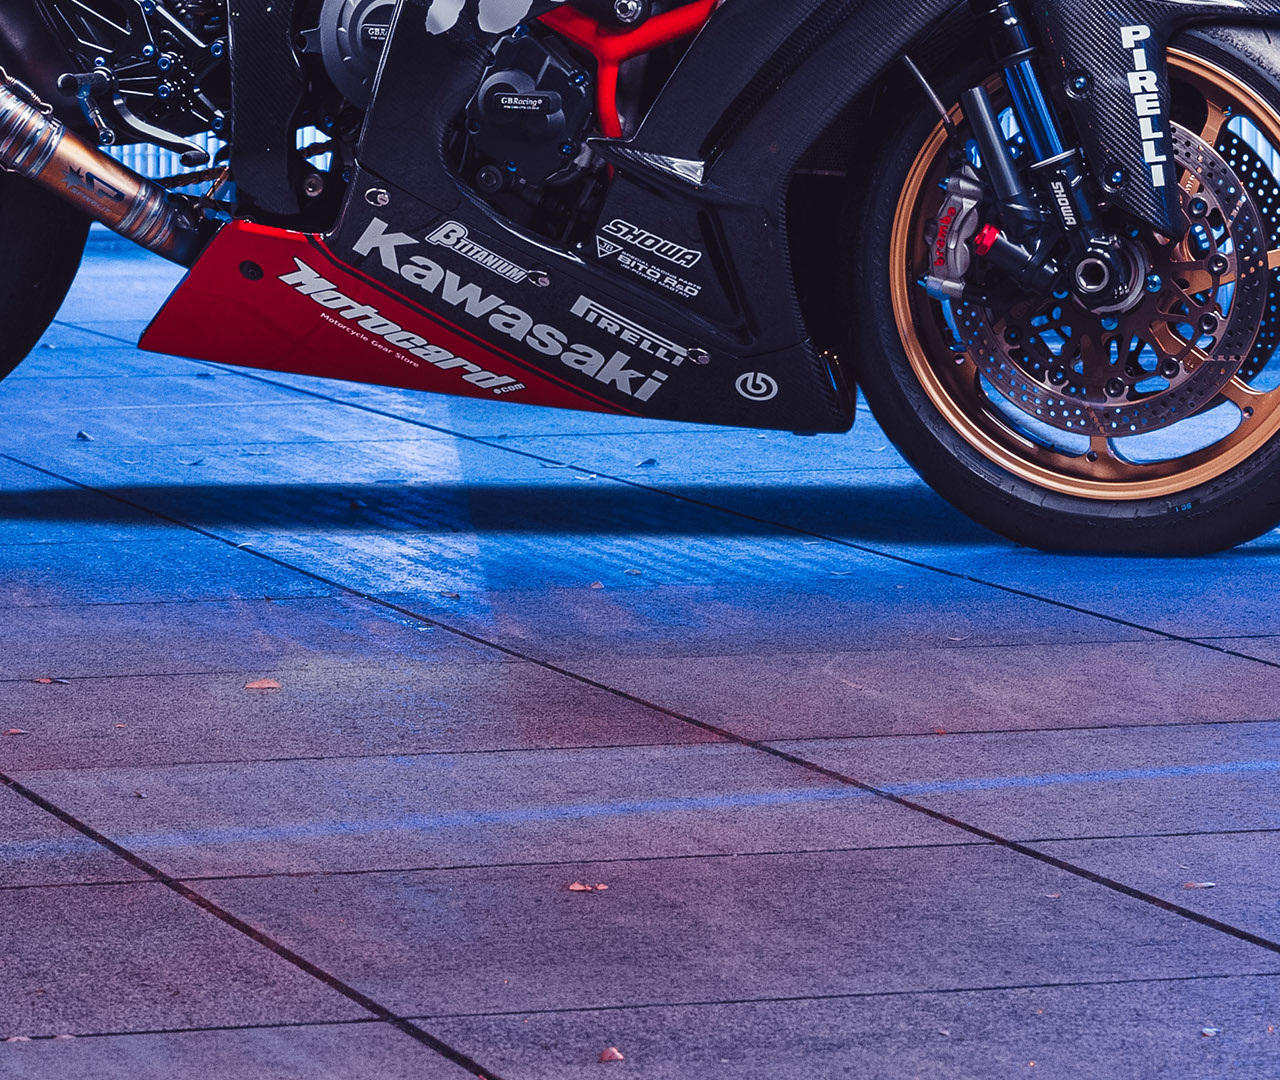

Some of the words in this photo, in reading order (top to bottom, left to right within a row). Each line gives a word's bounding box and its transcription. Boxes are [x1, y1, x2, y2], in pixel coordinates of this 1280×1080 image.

[1120, 24, 1167, 187] PIRELLI
[1051, 181, 1077, 226] SHOWA
[601, 219, 702, 269] SHOWA
[934, 207, 956, 267] brembo
[617, 253, 661, 280] BITO
[663, 276, 700, 297] R&D
[621, 251, 650, 267] SPECIAL
[651, 265, 678, 280] RACING
[678, 277, 702, 290] PARTS
[352, 216, 669, 403] Kawasaki
[570, 294, 689, 367] PIRELLI
[320, 312, 369, 342] Motorcycle
[371, 340, 394, 354] Gear
[394, 352, 420, 368] Store
